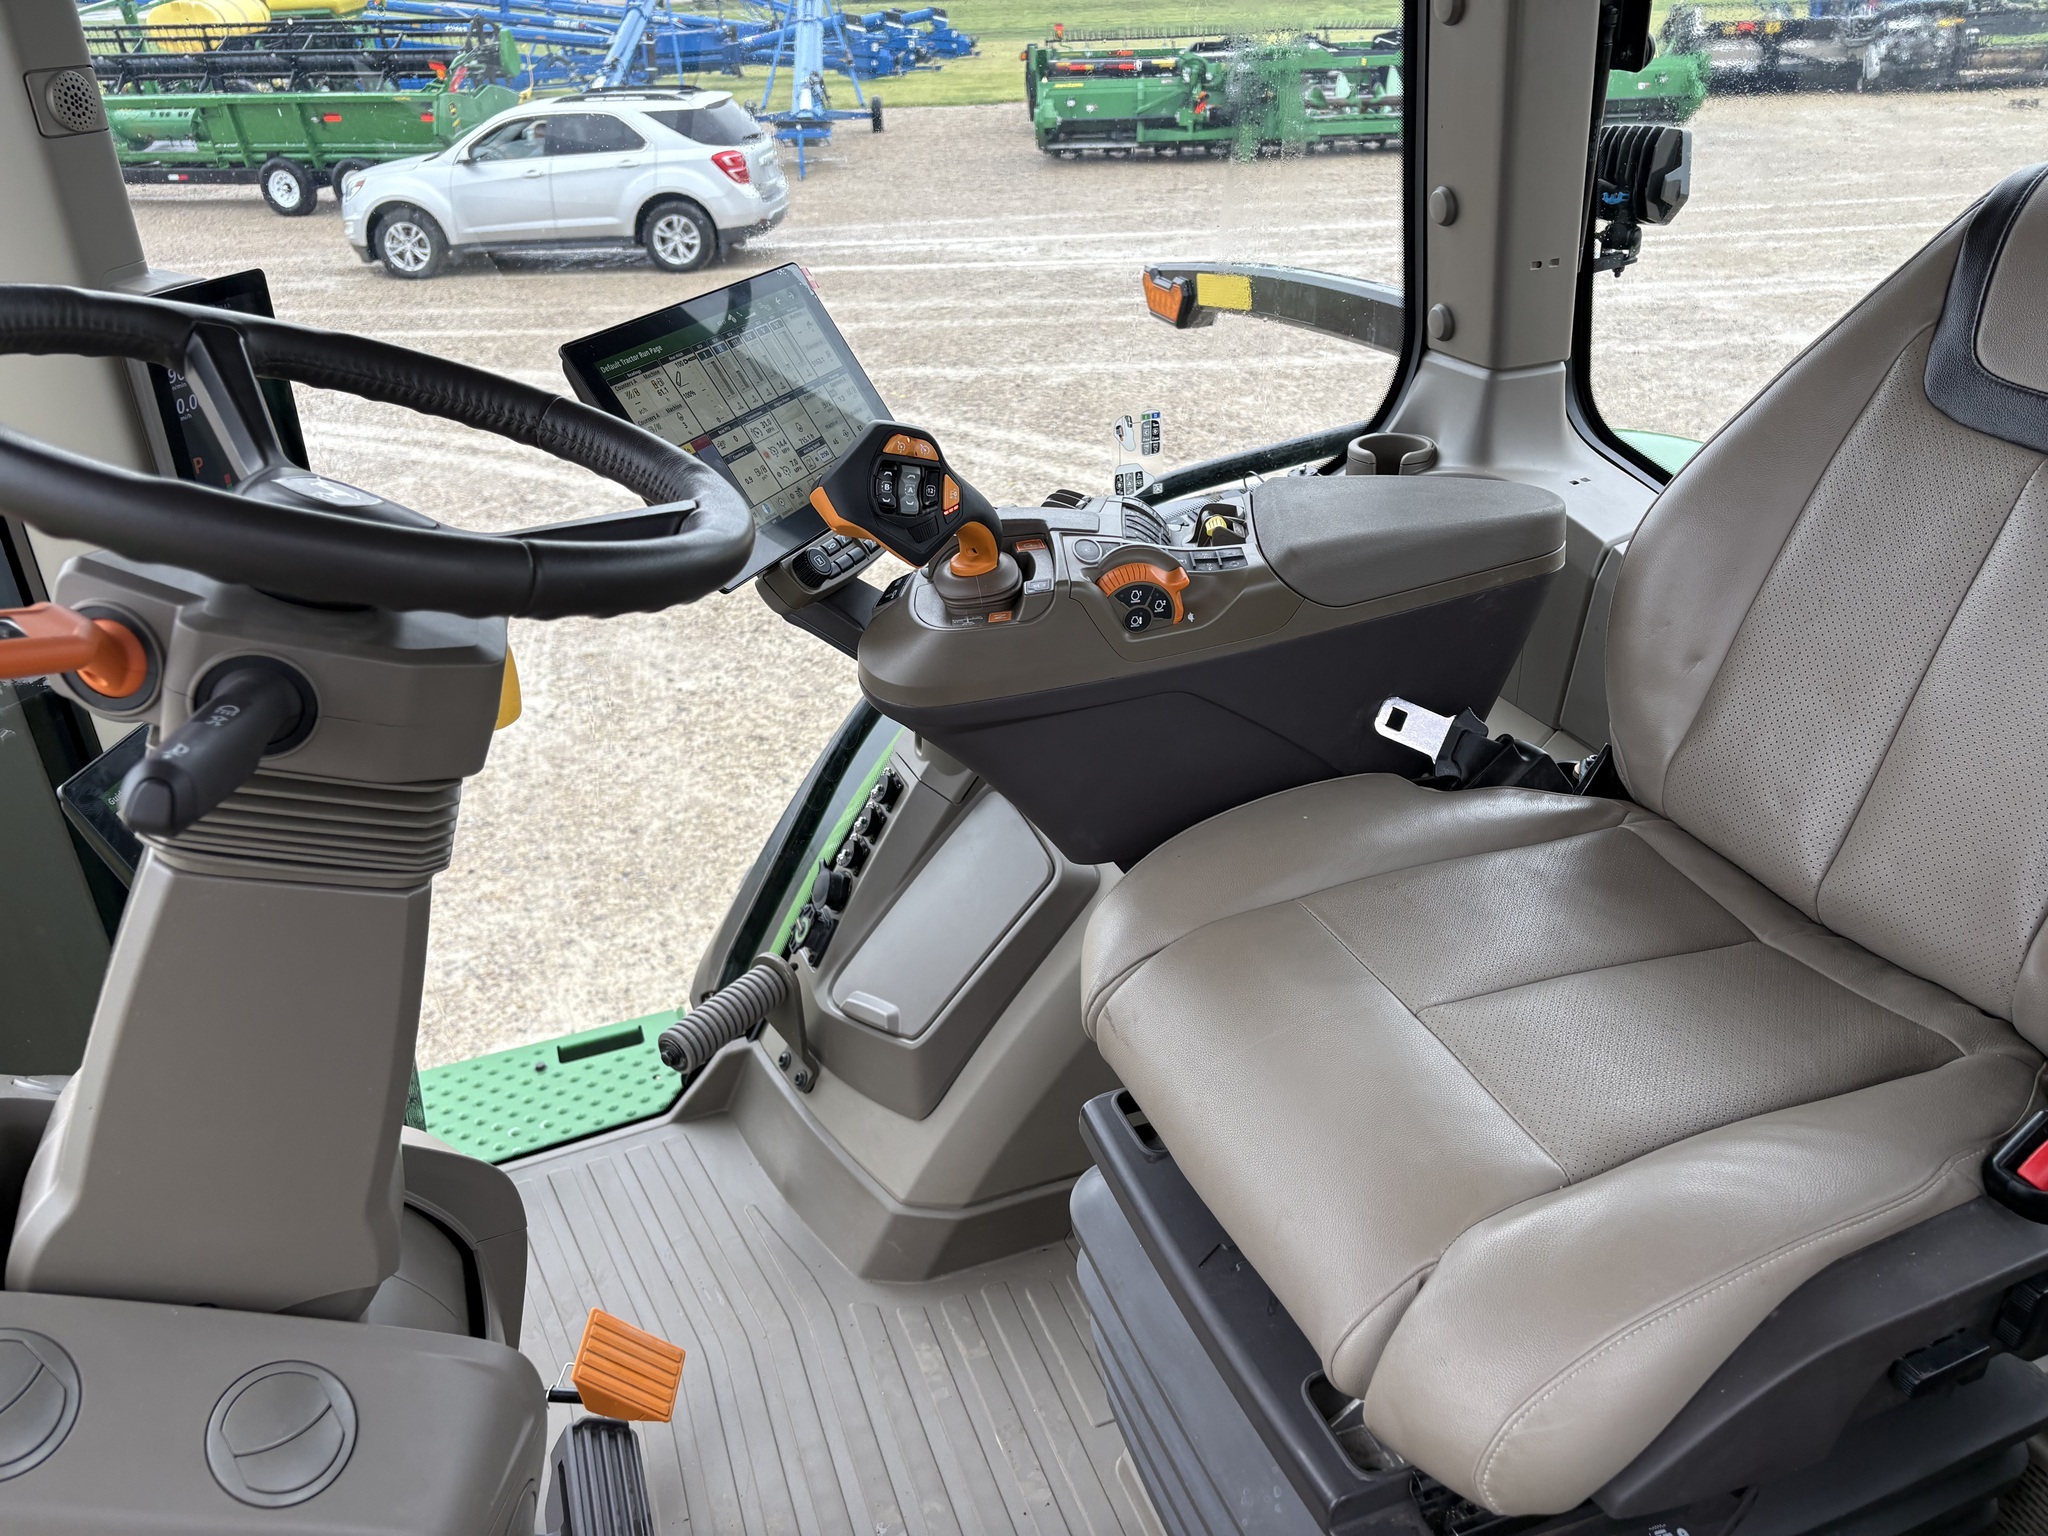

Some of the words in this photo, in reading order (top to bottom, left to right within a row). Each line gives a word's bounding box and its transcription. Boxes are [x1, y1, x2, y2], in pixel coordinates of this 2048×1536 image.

[600, 361, 622, 373] Default
[620, 354, 640, 365] Tractor
[638, 350, 651, 358] Run
[649, 345, 664, 356] Page
[643, 370, 661, 379] Machine
[615, 381, 634, 391] Counters
[656, 387, 670, 396] 61.1
[683, 390, 697, 399] 100%
[176, 394, 198, 415] 0.0
[665, 403, 683, 413] Machine
[637, 416, 657, 426] Counters
[760, 419, 773, 428] 31.0
[776, 439, 788, 448] 14.4
[193, 457, 204, 475] P
[789, 459, 799, 467] 7.0
[744, 476, 755, 485] 0.9
